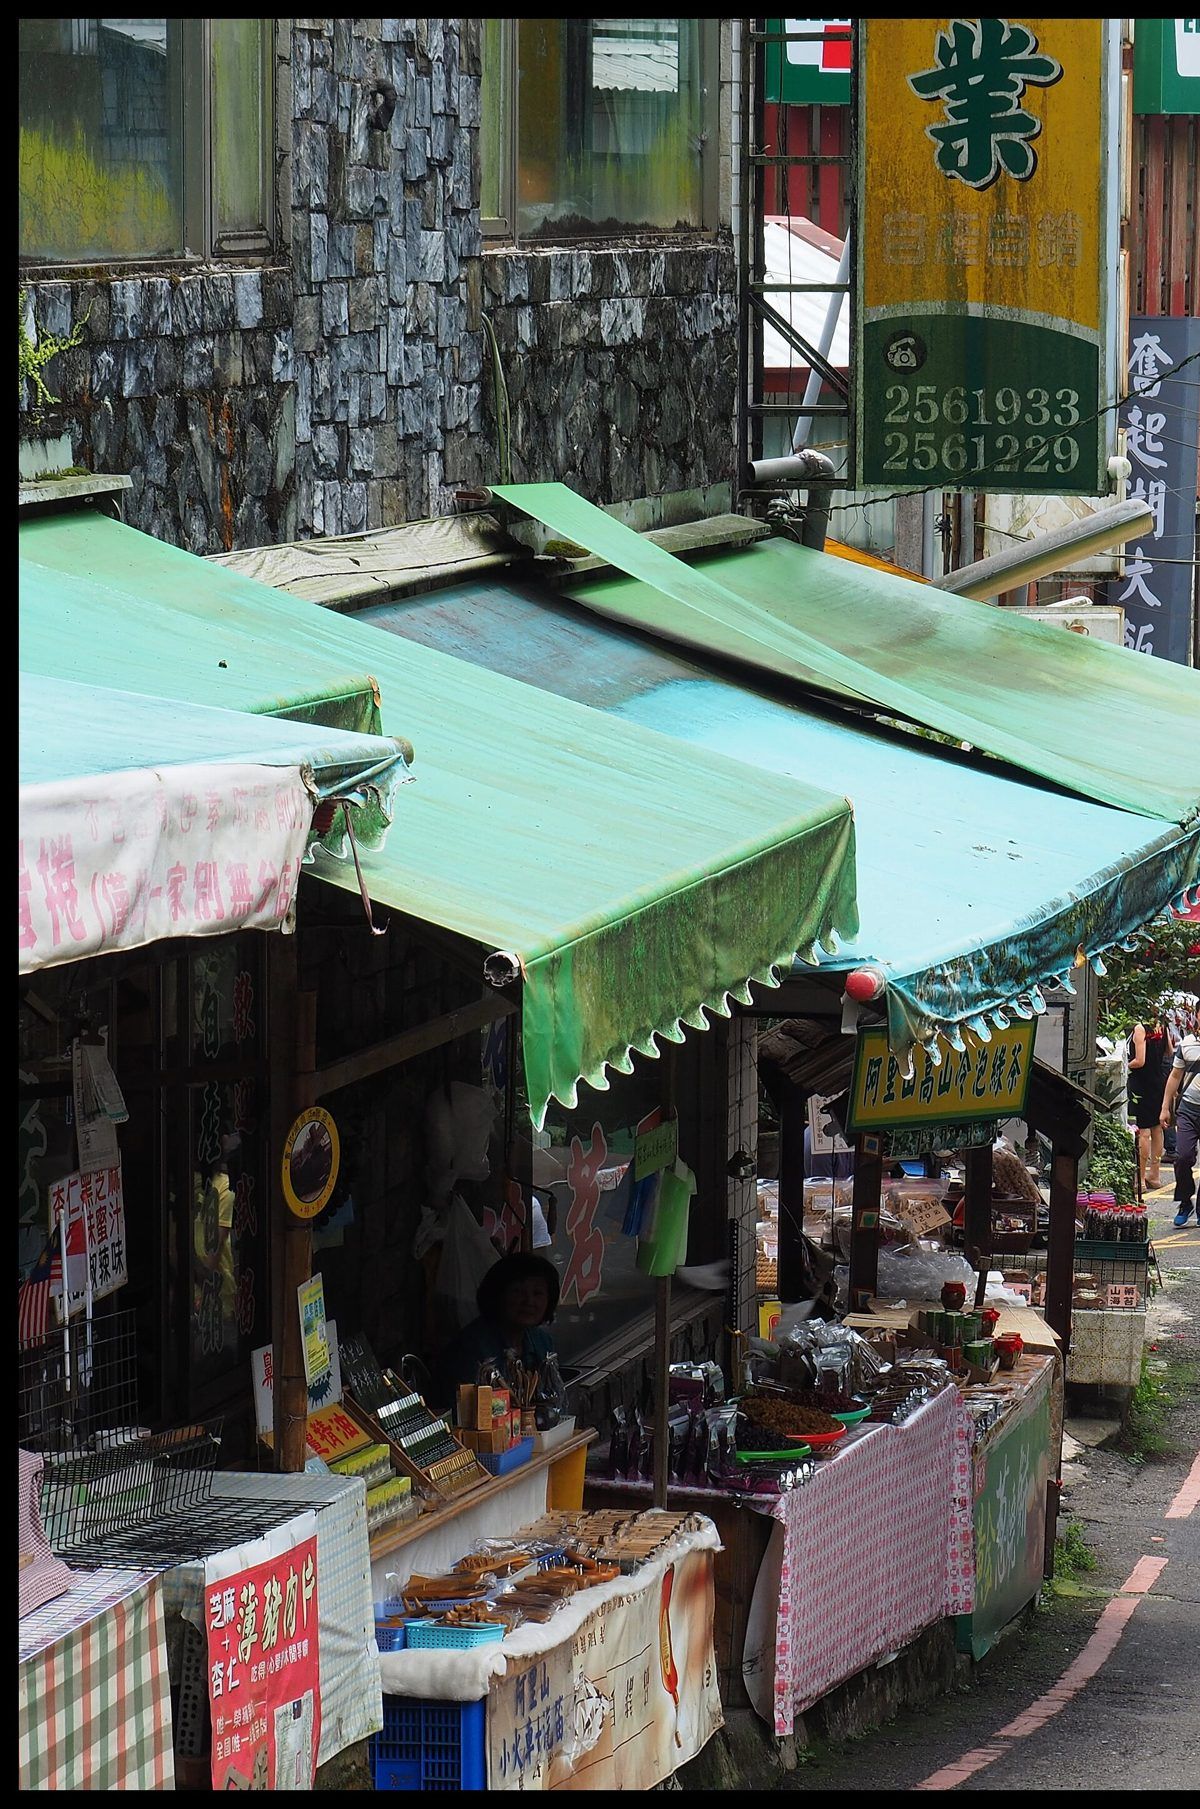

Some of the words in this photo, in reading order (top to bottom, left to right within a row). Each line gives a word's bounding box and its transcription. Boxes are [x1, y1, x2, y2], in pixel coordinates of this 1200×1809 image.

[907, 18, 1064, 192] 業
[884, 385, 1079, 426] 2561933
[882, 432, 1080, 474] 2561229
[209, 1586, 236, 1631] 芝麻
[211, 1653, 240, 1700] 杏仁
